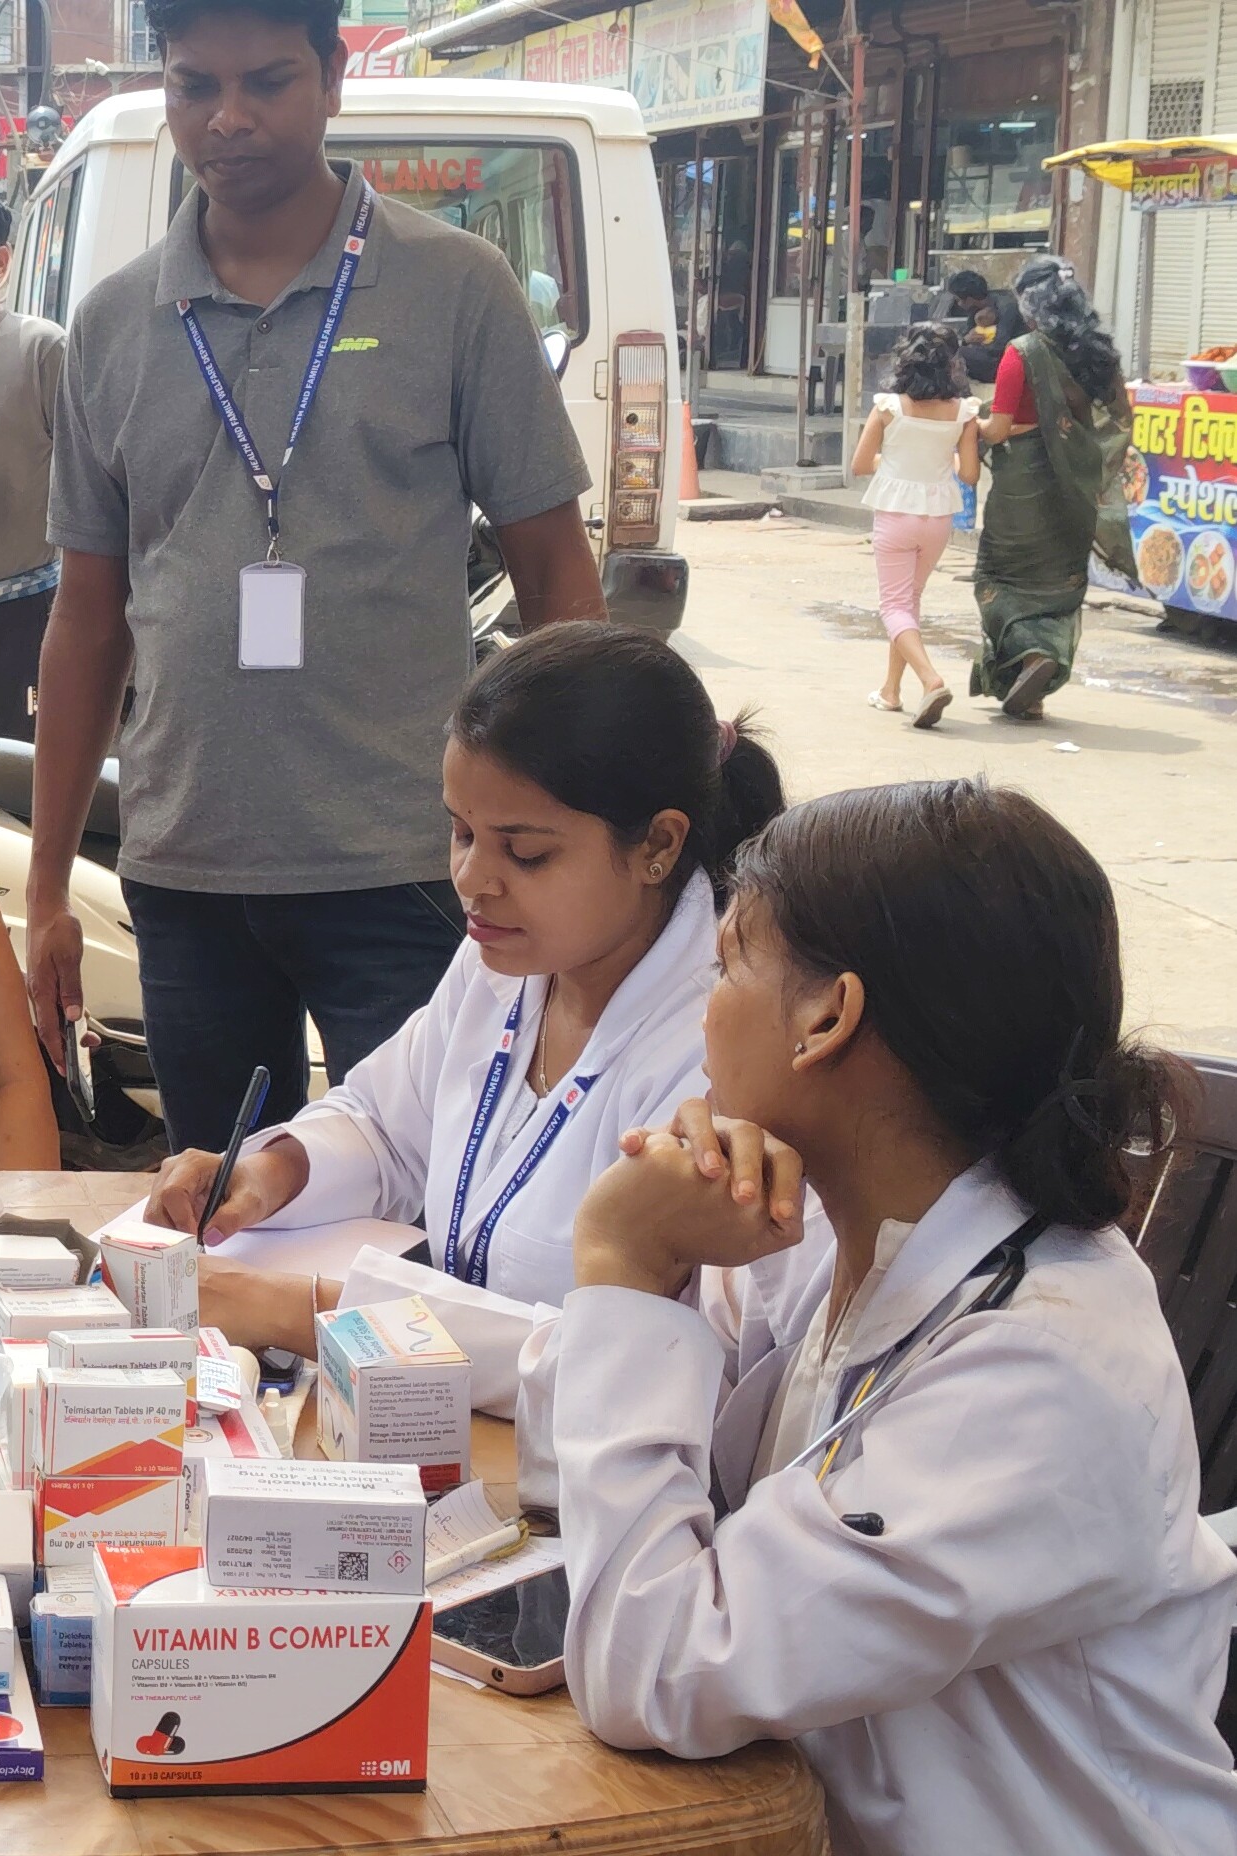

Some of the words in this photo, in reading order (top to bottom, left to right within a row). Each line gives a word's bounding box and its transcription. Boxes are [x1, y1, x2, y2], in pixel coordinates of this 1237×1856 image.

[186, 316, 211, 367] DEPARTMENT
[289, 411, 303, 443] HEALTH
[300, 390, 310, 412] AND
[306, 358, 322, 391] FAMILY
[314, 319, 334, 358] WELFARE
[328, 258, 354, 318] DEPARTMENT
[205, 366, 227, 401] WELFARE
[221, 399, 240, 427] FAMILY
[234, 426, 248, 443] AND
[1132, 405, 1181, 457] बटर
[243, 440, 262, 472] HEALTH
[451, 1193, 463, 1235] FAMILY
[458, 1137, 478, 1191] WELFARE
[474, 1060, 504, 1136] DEPARTMENT
[516, 1111, 562, 1182] DEPARTMENT
[486, 1180, 517, 1231] WELFARE
[474, 1231, 491, 1273] FAMILY
[470, 1268, 483, 1285] ND
[160, 1361, 167, 1369] IP
[180, 1361, 192, 1370] mg
[64, 1406, 112, 1415] Telmisartan
[113, 1406, 144, 1415] Tablets
[146, 1407, 155, 1415] IP
[156, 1407, 166, 1416] 40
[168, 1408, 182, 1417] mg
[258, 1479, 375, 1489] Metronidazole
[334, 1475, 392, 1483] Tablets
[49, 1539, 62, 1548] mg
[65, 1540, 75, 1548] 40
[77, 1540, 85, 1548] IP
[132, 1627, 237, 1651] VITAMIN
[247, 1627, 260, 1651] B
[269, 1625, 391, 1649] COMPLEX
[132, 1659, 190, 1670] CAPSULES
[160, 1771, 203, 1781] CAPSULES
[379, 1760, 411, 1776] 9M
